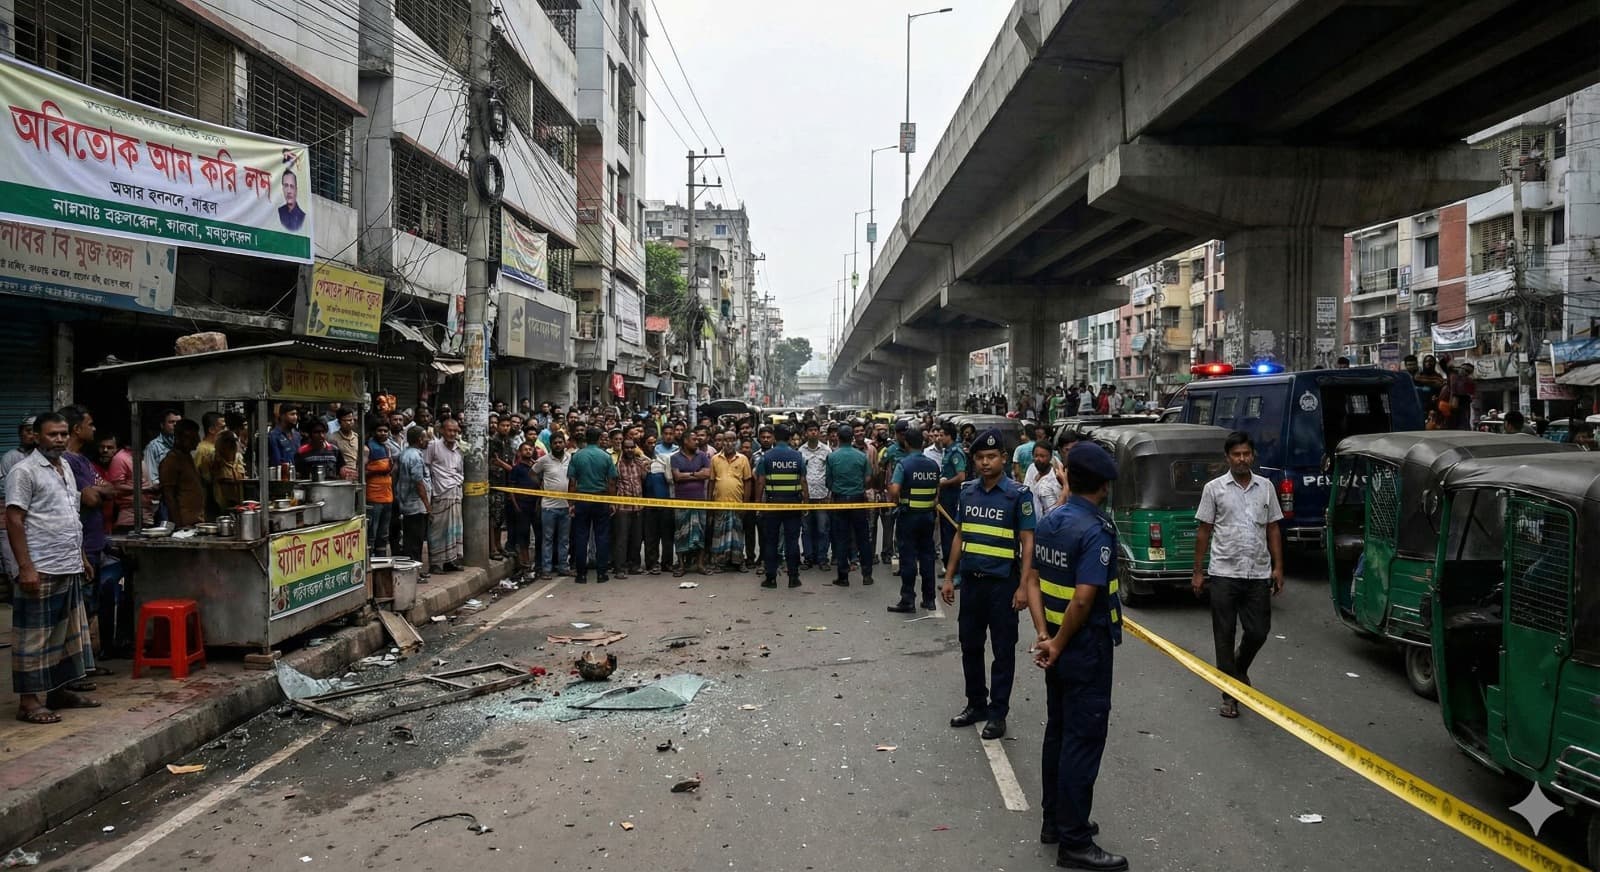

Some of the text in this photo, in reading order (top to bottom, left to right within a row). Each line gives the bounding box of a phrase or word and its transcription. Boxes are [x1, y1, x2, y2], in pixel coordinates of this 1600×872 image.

[8, 100, 141, 171] অবিতোক
[146, 141, 193, 184] আন
[198, 148, 238, 196] করি
[772, 460, 798, 470] POLICE
[912, 471, 937, 481] POLICE
[965, 505, 1004, 521] POLICE
[1035, 543, 1069, 569] POLICE
